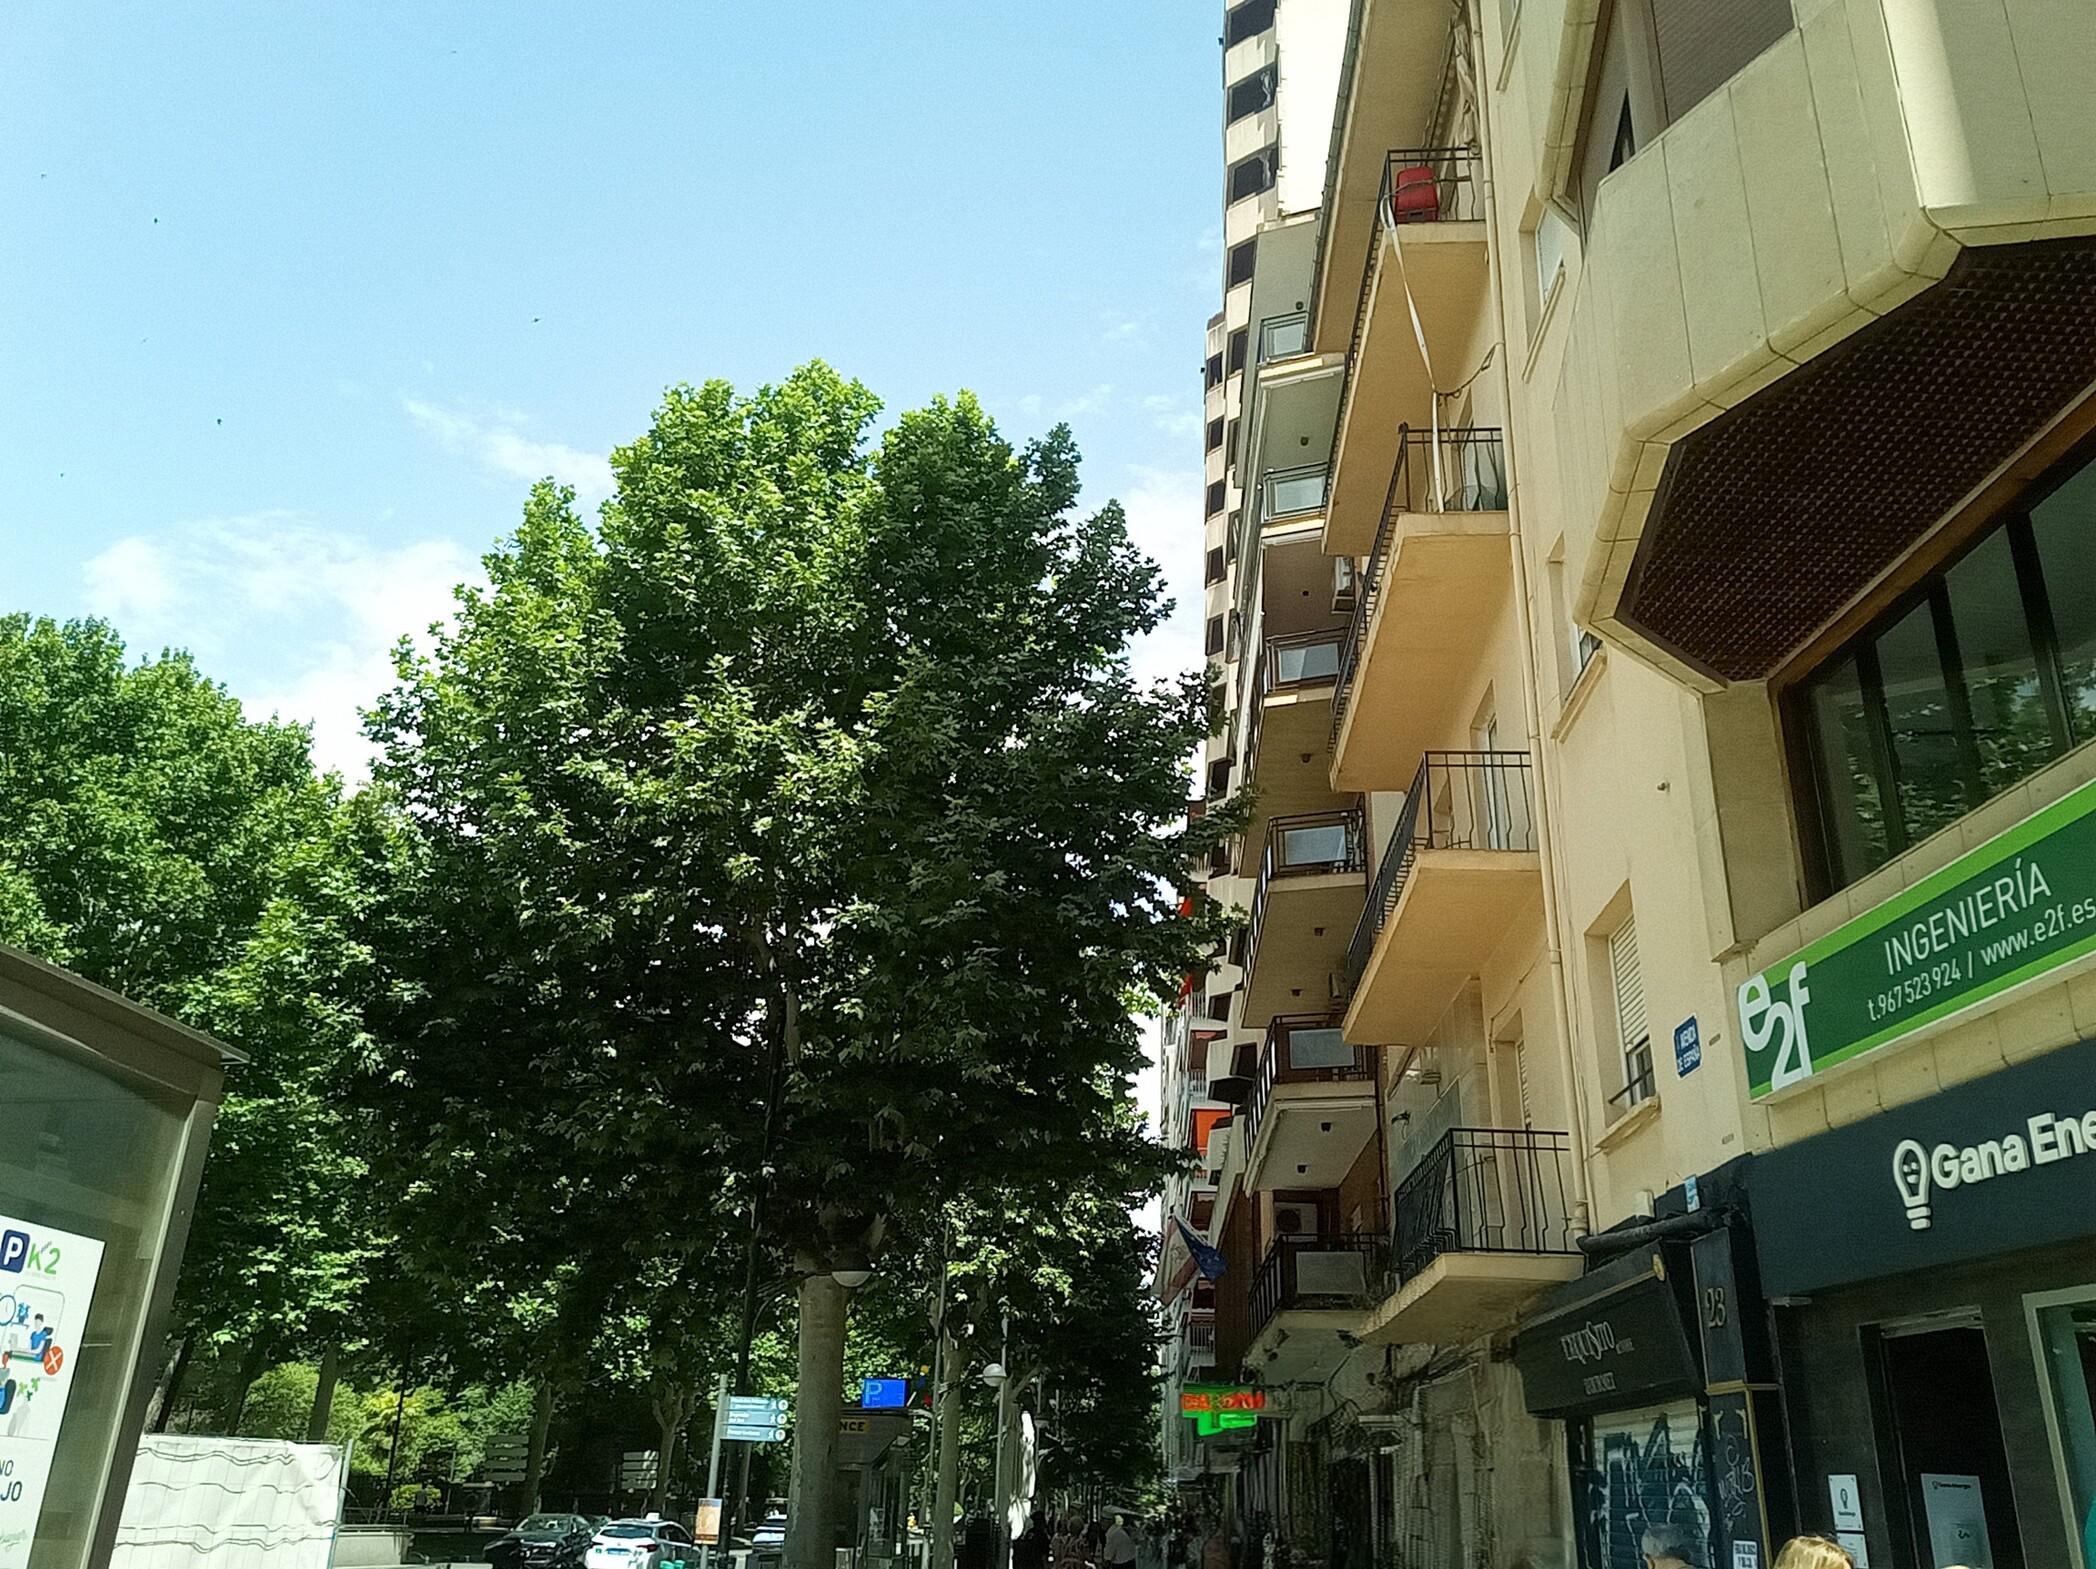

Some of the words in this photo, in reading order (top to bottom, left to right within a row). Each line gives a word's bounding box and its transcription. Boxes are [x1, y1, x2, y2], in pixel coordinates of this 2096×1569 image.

[1884, 857, 2052, 976] INGENIERÍA
[1980, 897, 2096, 967] www.e2f.es
[1738, 960, 1814, 1092] e2f
[1705, 1287, 1726, 1326] 23
[865, 1381, 883, 1404] P
